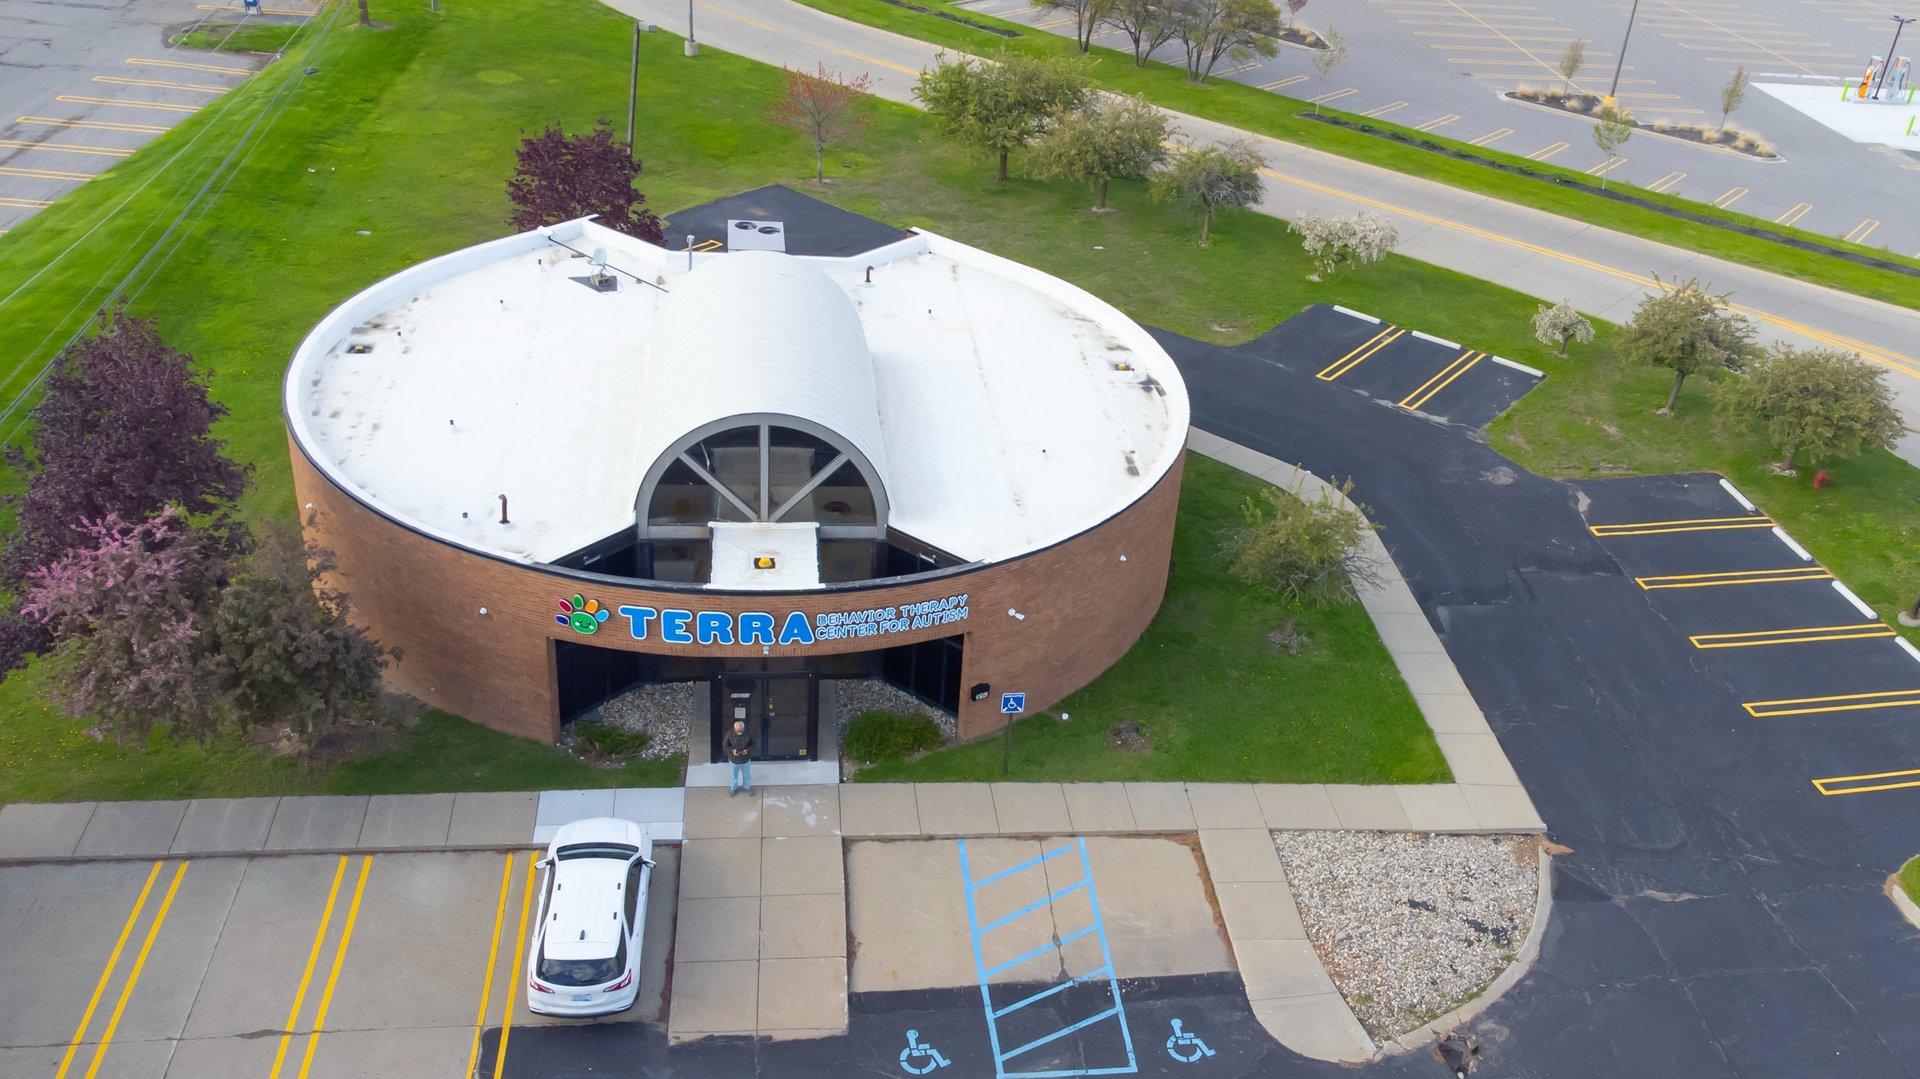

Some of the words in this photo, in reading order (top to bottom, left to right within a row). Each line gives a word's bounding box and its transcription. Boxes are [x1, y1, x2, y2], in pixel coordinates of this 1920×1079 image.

[618, 605, 815, 645] TERRA
[815, 622, 877, 640] CENTER
[879, 617, 910, 634] FOR
[912, 606, 969, 629] AUTISM
[816, 607, 896, 627] BEHAVIOR
[900, 594, 968, 617] THERAPY
